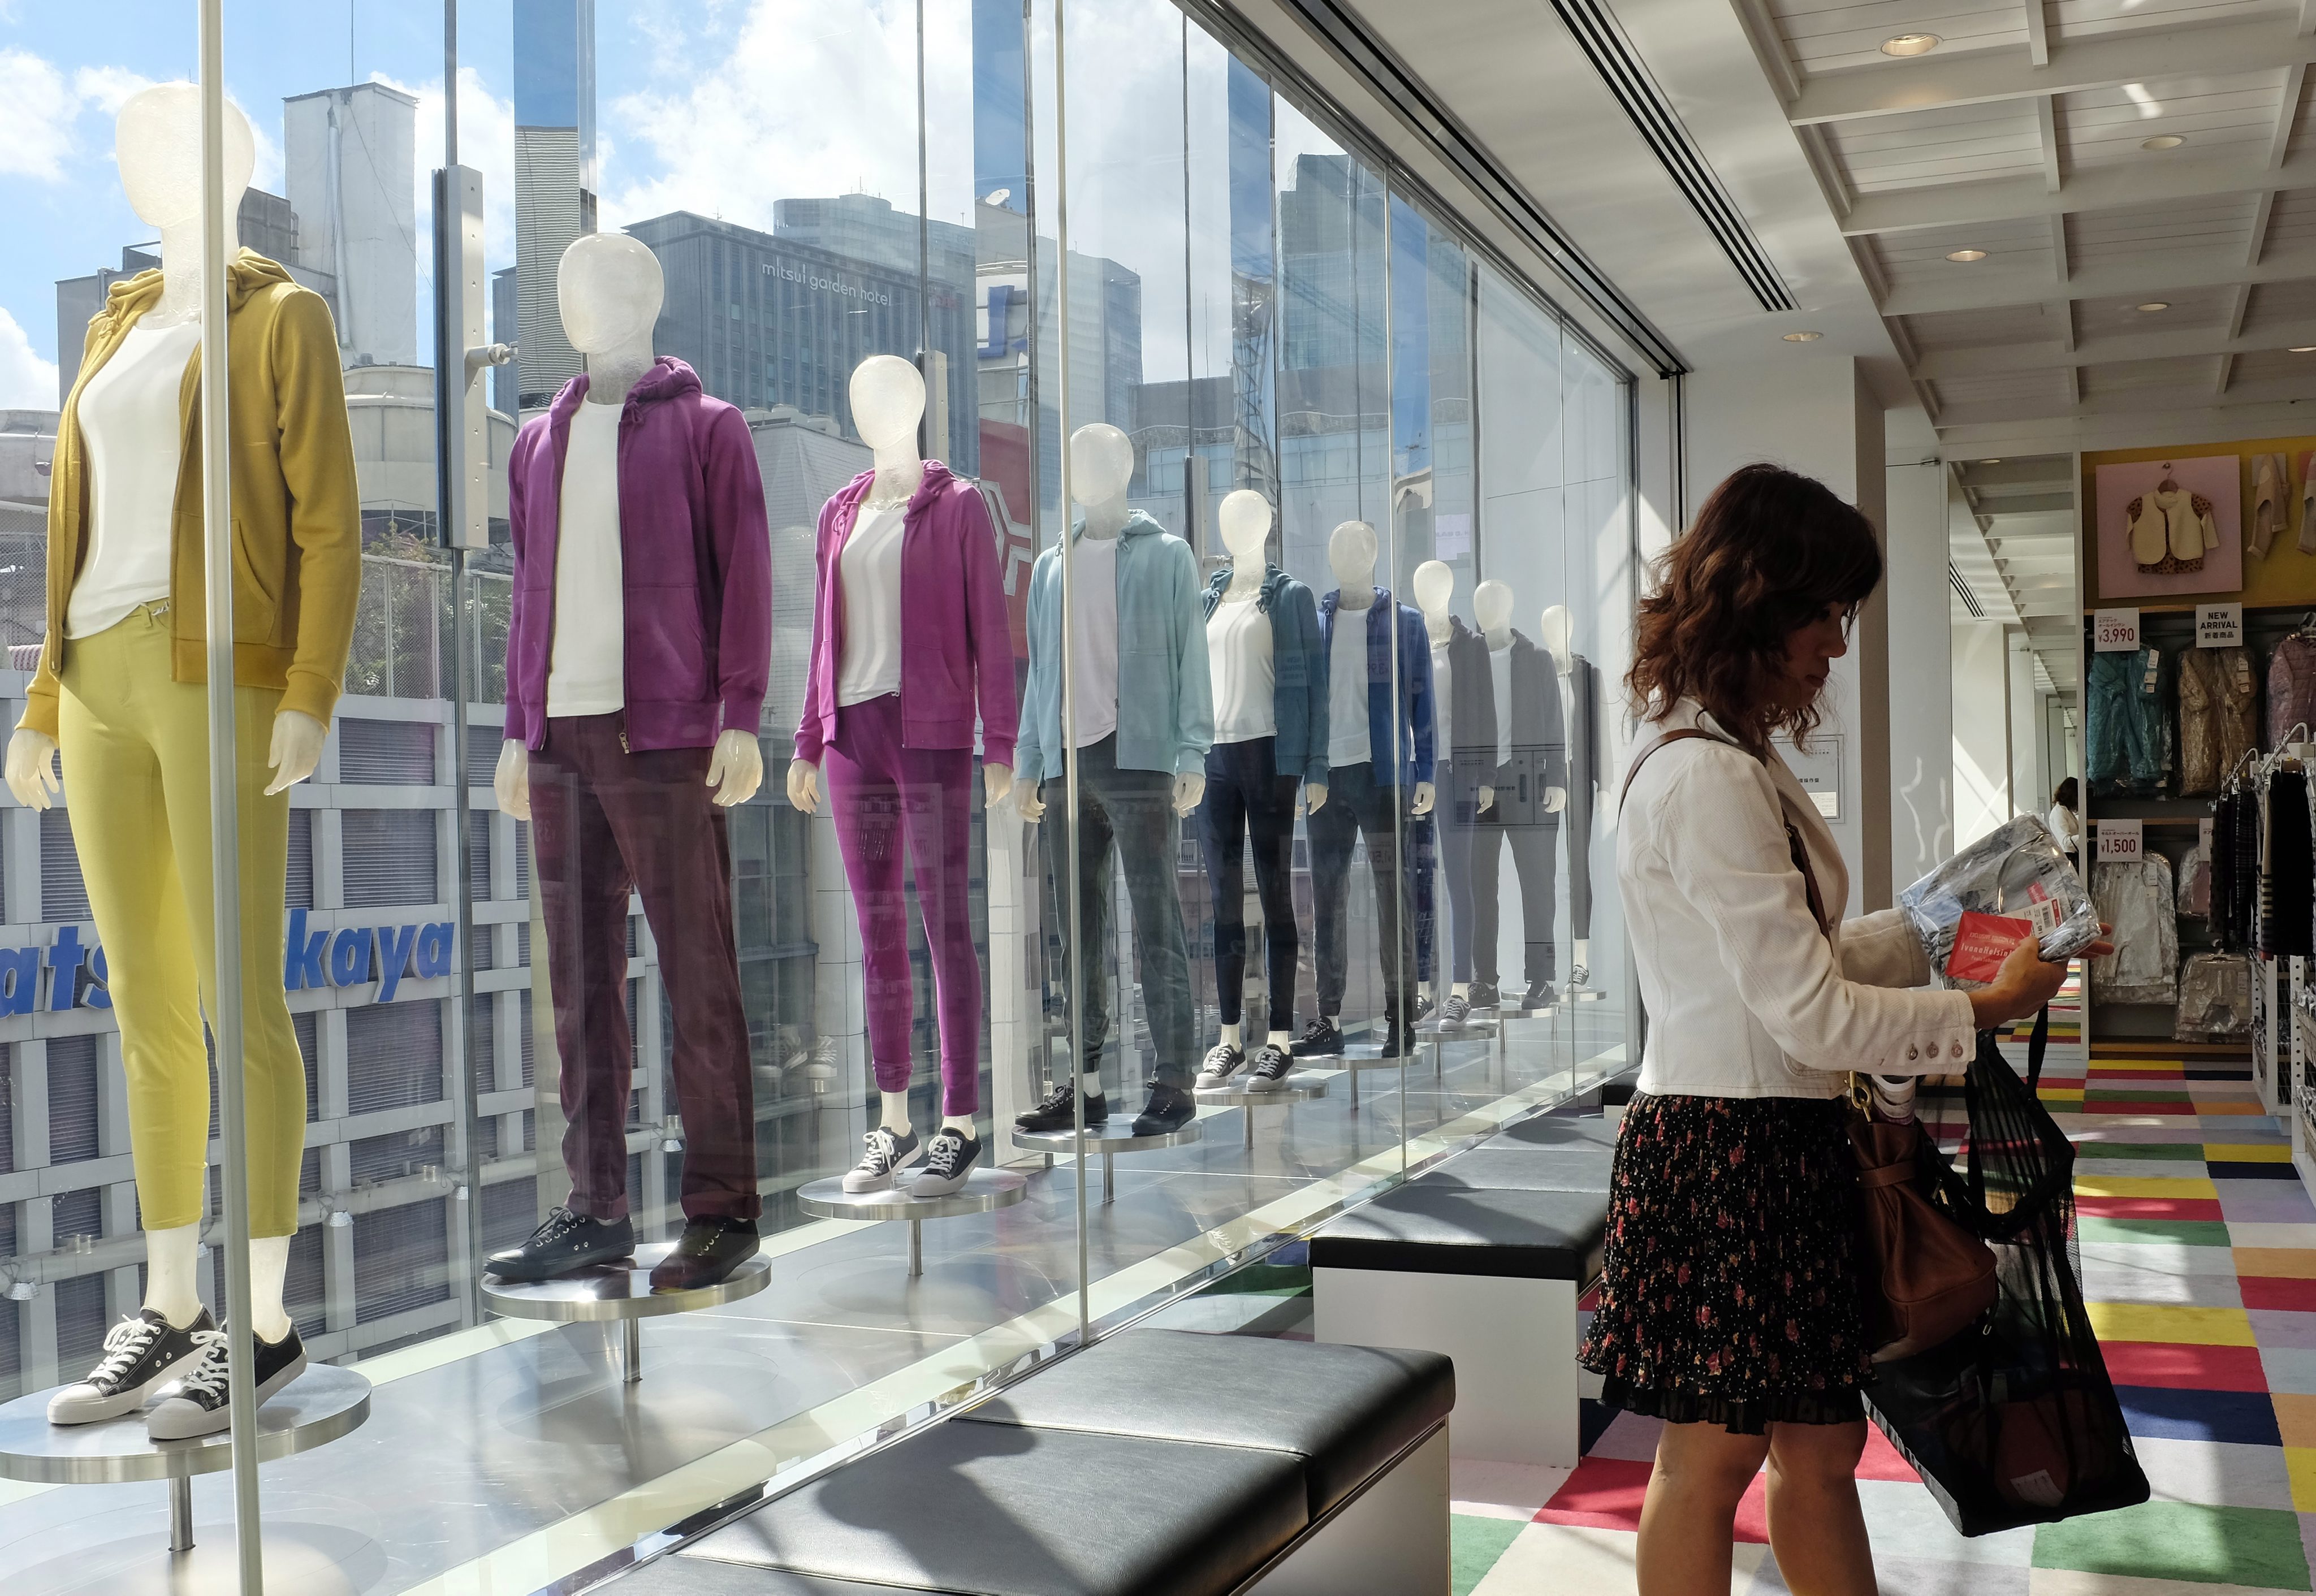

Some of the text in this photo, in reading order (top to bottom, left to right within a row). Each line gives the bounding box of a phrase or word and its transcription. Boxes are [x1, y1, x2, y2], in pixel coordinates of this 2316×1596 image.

[762, 257, 891, 306] mitsui garden hotel
[2200, 621, 2238, 629] ARRIVAL
[2098, 628, 2134, 643] ¥3,990
[2101, 839, 2136, 854] ¥1,500
